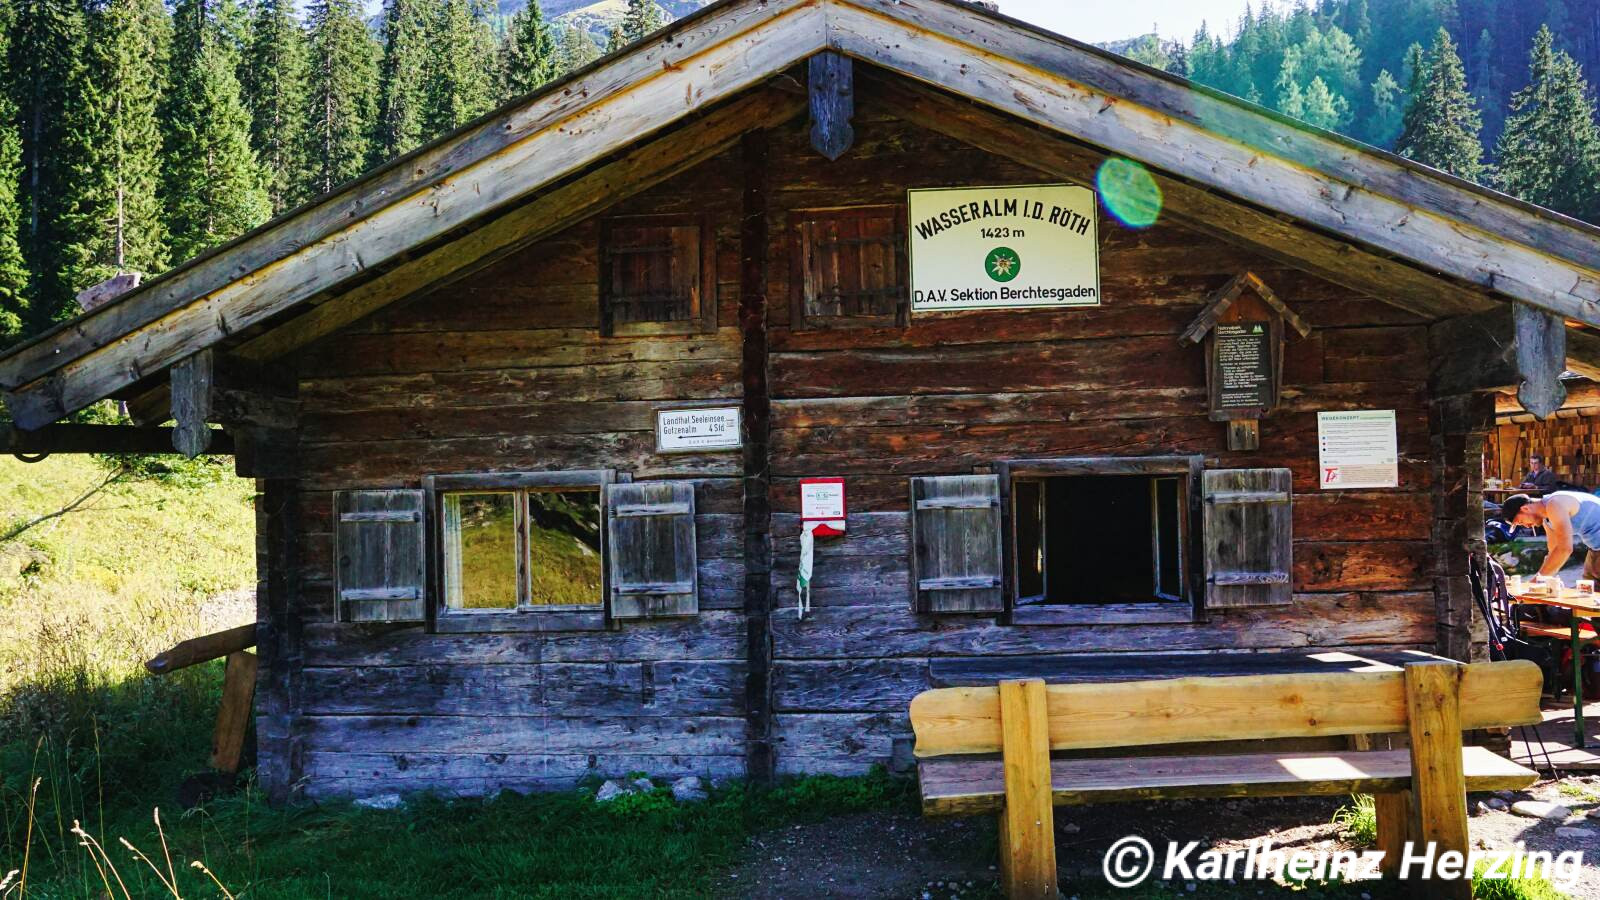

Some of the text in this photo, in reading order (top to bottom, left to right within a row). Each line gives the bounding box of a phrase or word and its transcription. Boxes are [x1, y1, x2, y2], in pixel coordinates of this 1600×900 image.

[915, 198, 1091, 240] WASSERALM I.D. RÖTH
[980, 227, 1025, 239] 1423 m
[914, 284, 1096, 303] D.A.V. Sektion Berchtesgaden
[708, 424, 713, 432] 4
